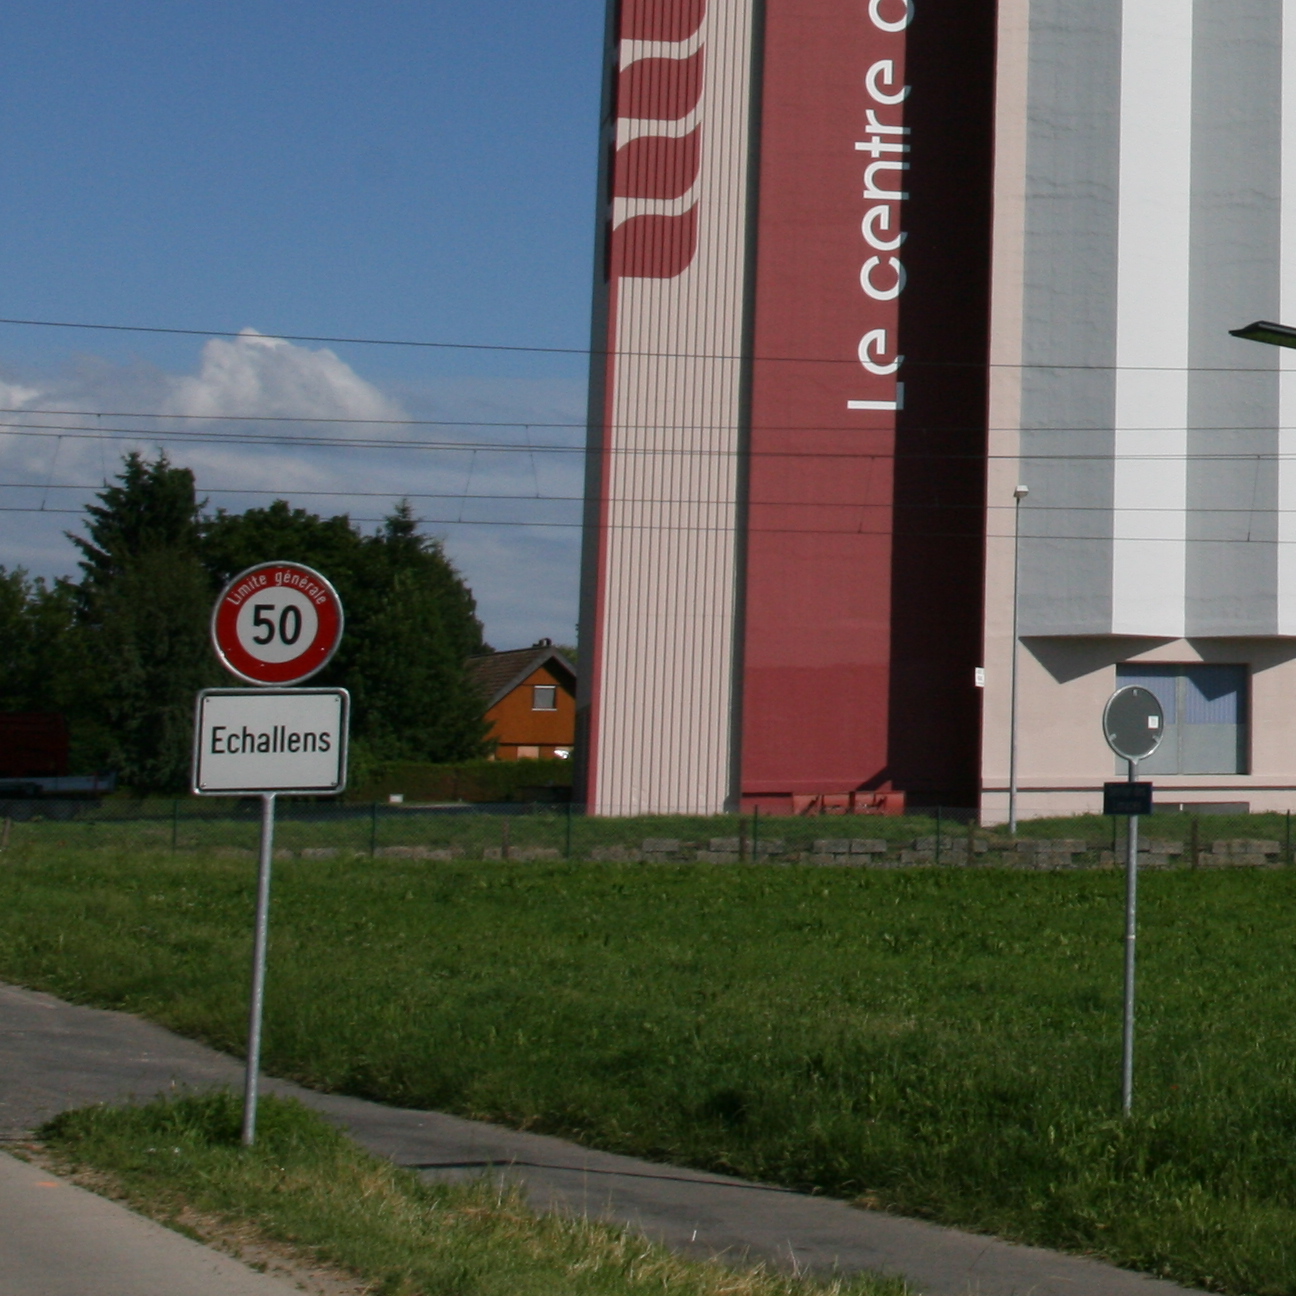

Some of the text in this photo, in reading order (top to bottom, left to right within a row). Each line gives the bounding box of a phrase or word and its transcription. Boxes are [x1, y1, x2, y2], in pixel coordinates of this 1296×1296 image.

[854, 58, 911, 301] centre
[846, 328, 905, 410] Le
[226, 570, 327, 605] Limite générale
[252, 604, 302, 645] 50
[211, 725, 331, 754] Echallens
